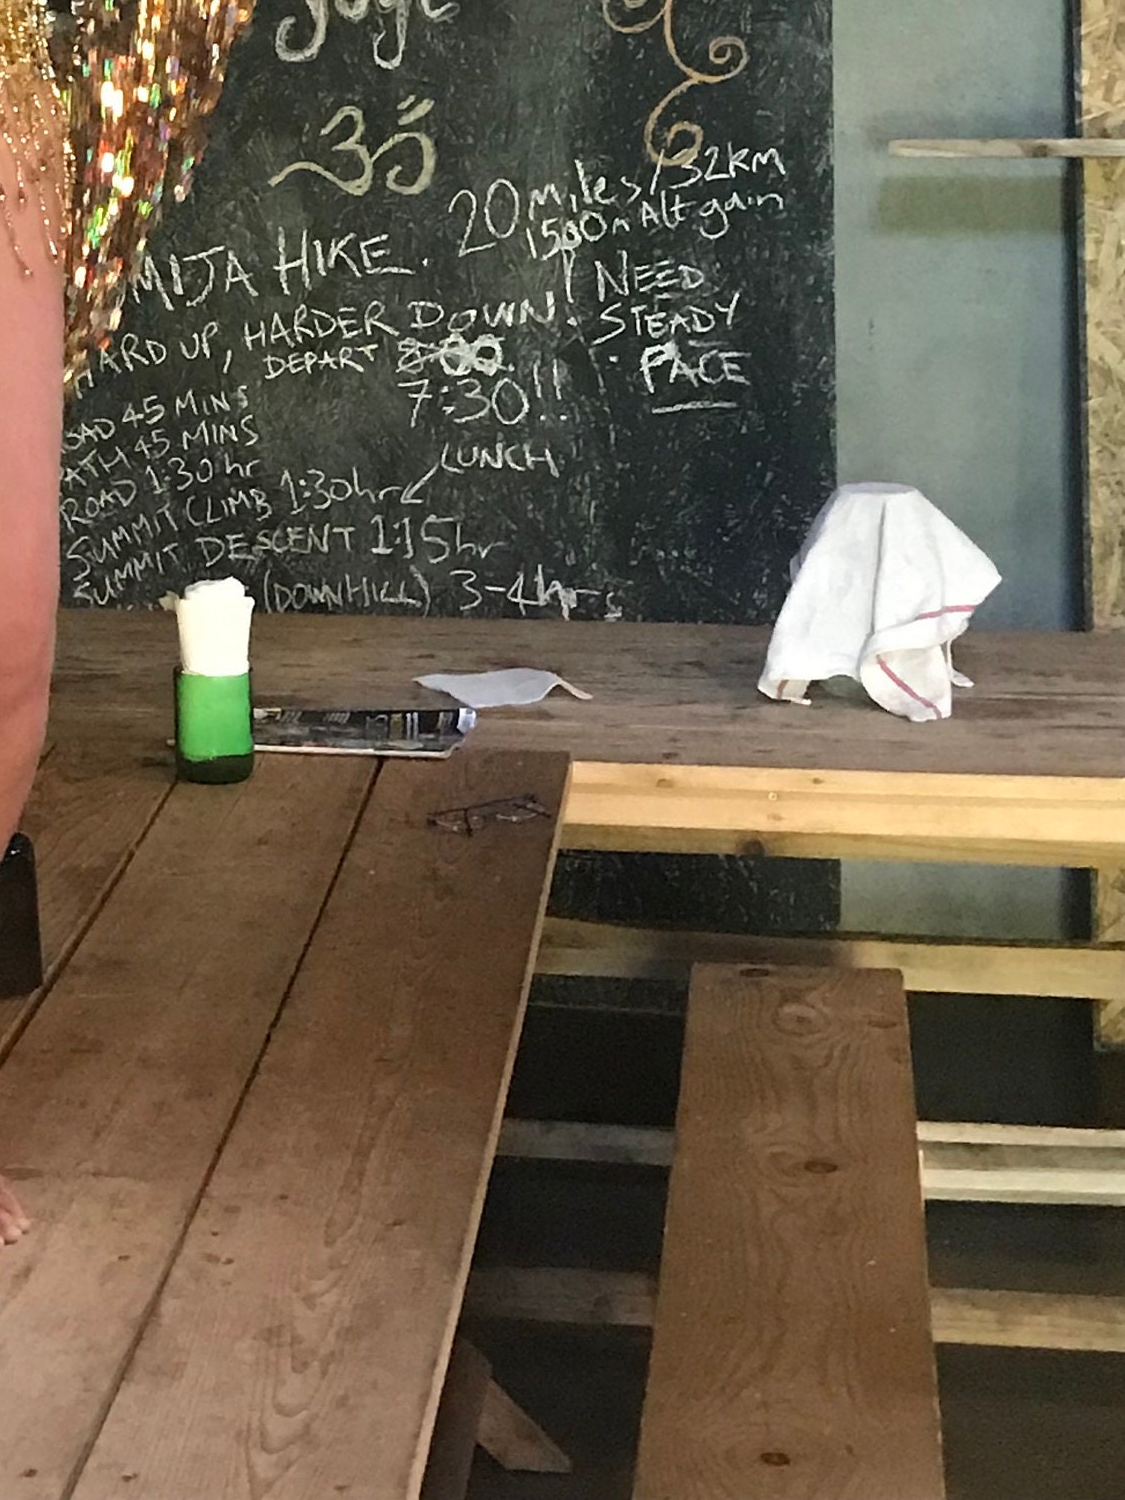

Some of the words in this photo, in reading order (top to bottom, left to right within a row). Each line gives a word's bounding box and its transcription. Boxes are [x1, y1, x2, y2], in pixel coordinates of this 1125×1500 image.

[447, 177, 521, 258] 20
[698, 188, 785, 240] gain
[593, 249, 706, 303] NEED
[243, 300, 401, 350] HARDER
[590, 291, 741, 347] STEADY
[262, 344, 380, 380] DEPART
[638, 339, 752, 393] PACE
[61, 418, 116, 454] OAD
[121, 394, 166, 429] 45
[174, 385, 249, 418] MINS
[62, 445, 133, 491] ATH
[134, 427, 172, 460] 45
[181, 414, 261, 451] MINS
[440, 442, 561, 479] LUNCH
[59, 478, 138, 533] ROAD
[65, 502, 179, 583] SUMMIT
[185, 487, 273, 528] CLIMB
[72, 541, 180, 606] SUMMIT
[194, 526, 356, 568] DESCENT
